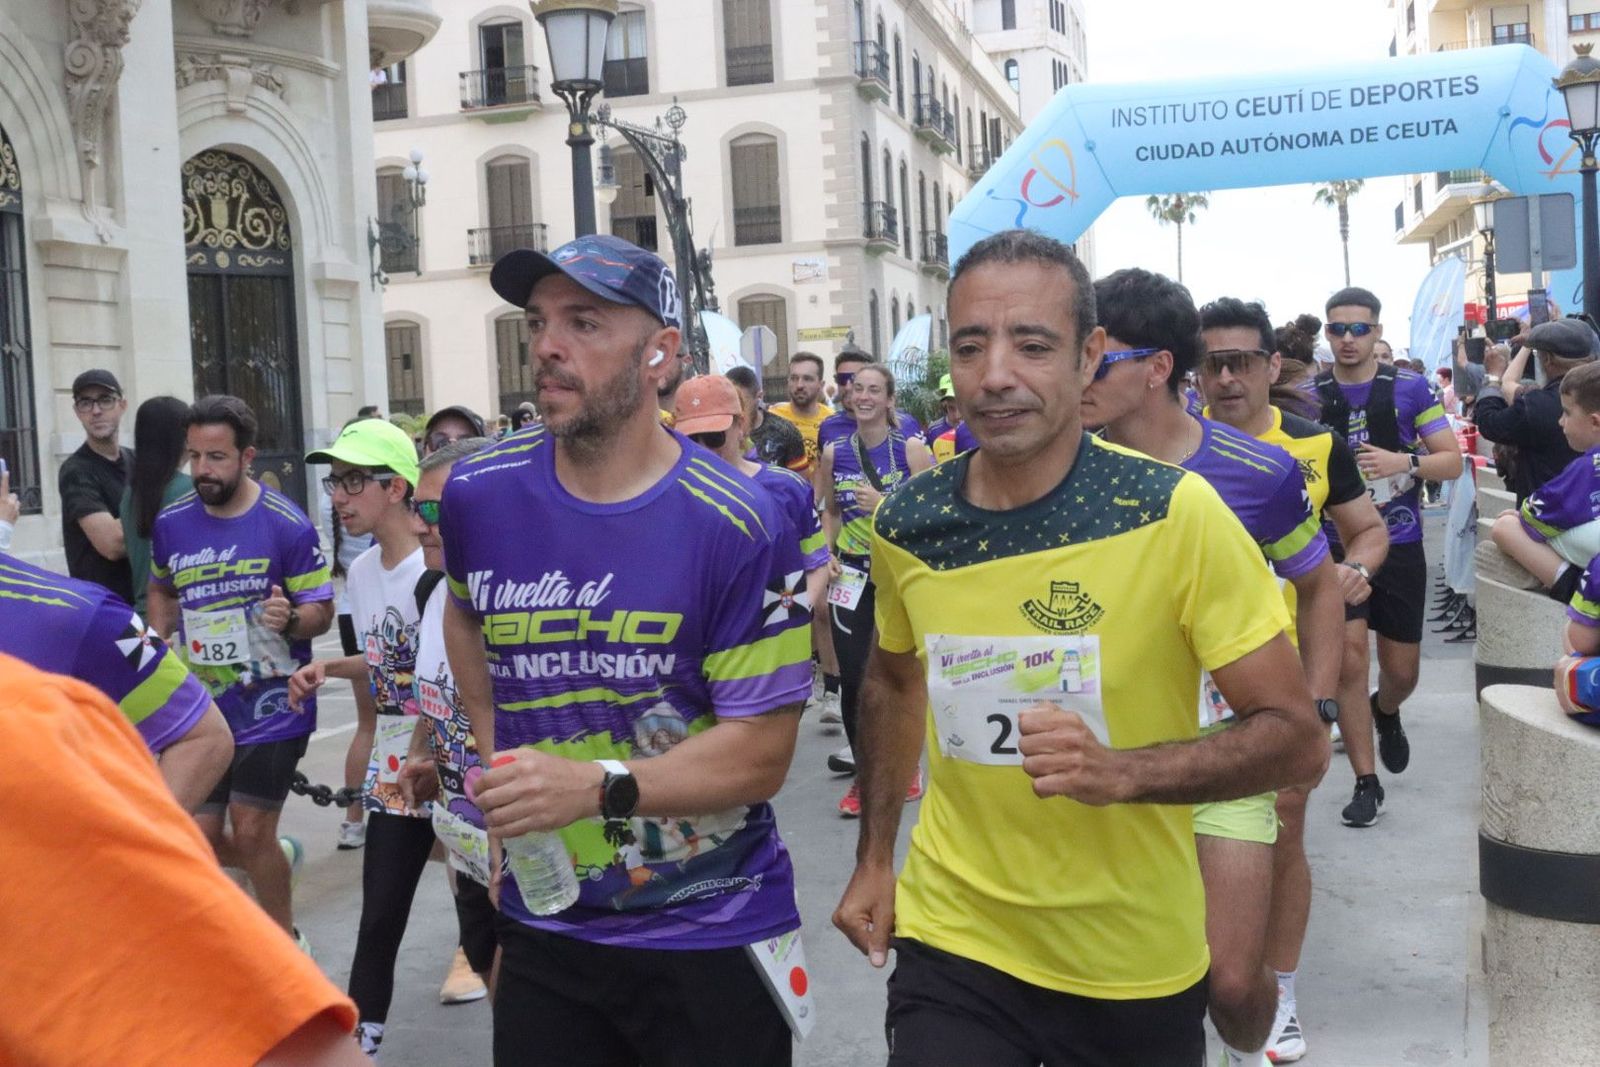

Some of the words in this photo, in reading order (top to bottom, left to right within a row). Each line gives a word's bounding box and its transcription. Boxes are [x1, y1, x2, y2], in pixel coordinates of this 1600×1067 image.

[1111, 100, 1228, 128] INSTITUTO
[1235, 88, 1304, 118] CEUTÍ
[1310, 88, 1342, 113] DE
[1351, 75, 1480, 107] DEPORTES
[1135, 140, 1215, 162] CIUDAD
[1220, 130, 1344, 156] AUTÓNOMA
[1351, 126, 1379, 144] DE
[1385, 118, 1458, 141] CEUTA
[494, 570, 576, 610] vuelta
[575, 572, 615, 607] al
[1025, 602, 1062, 628] TRAIL
[1065, 605, 1098, 628] RACE
[202, 642, 239, 661] 182
[1023, 649, 1056, 668] 10K
